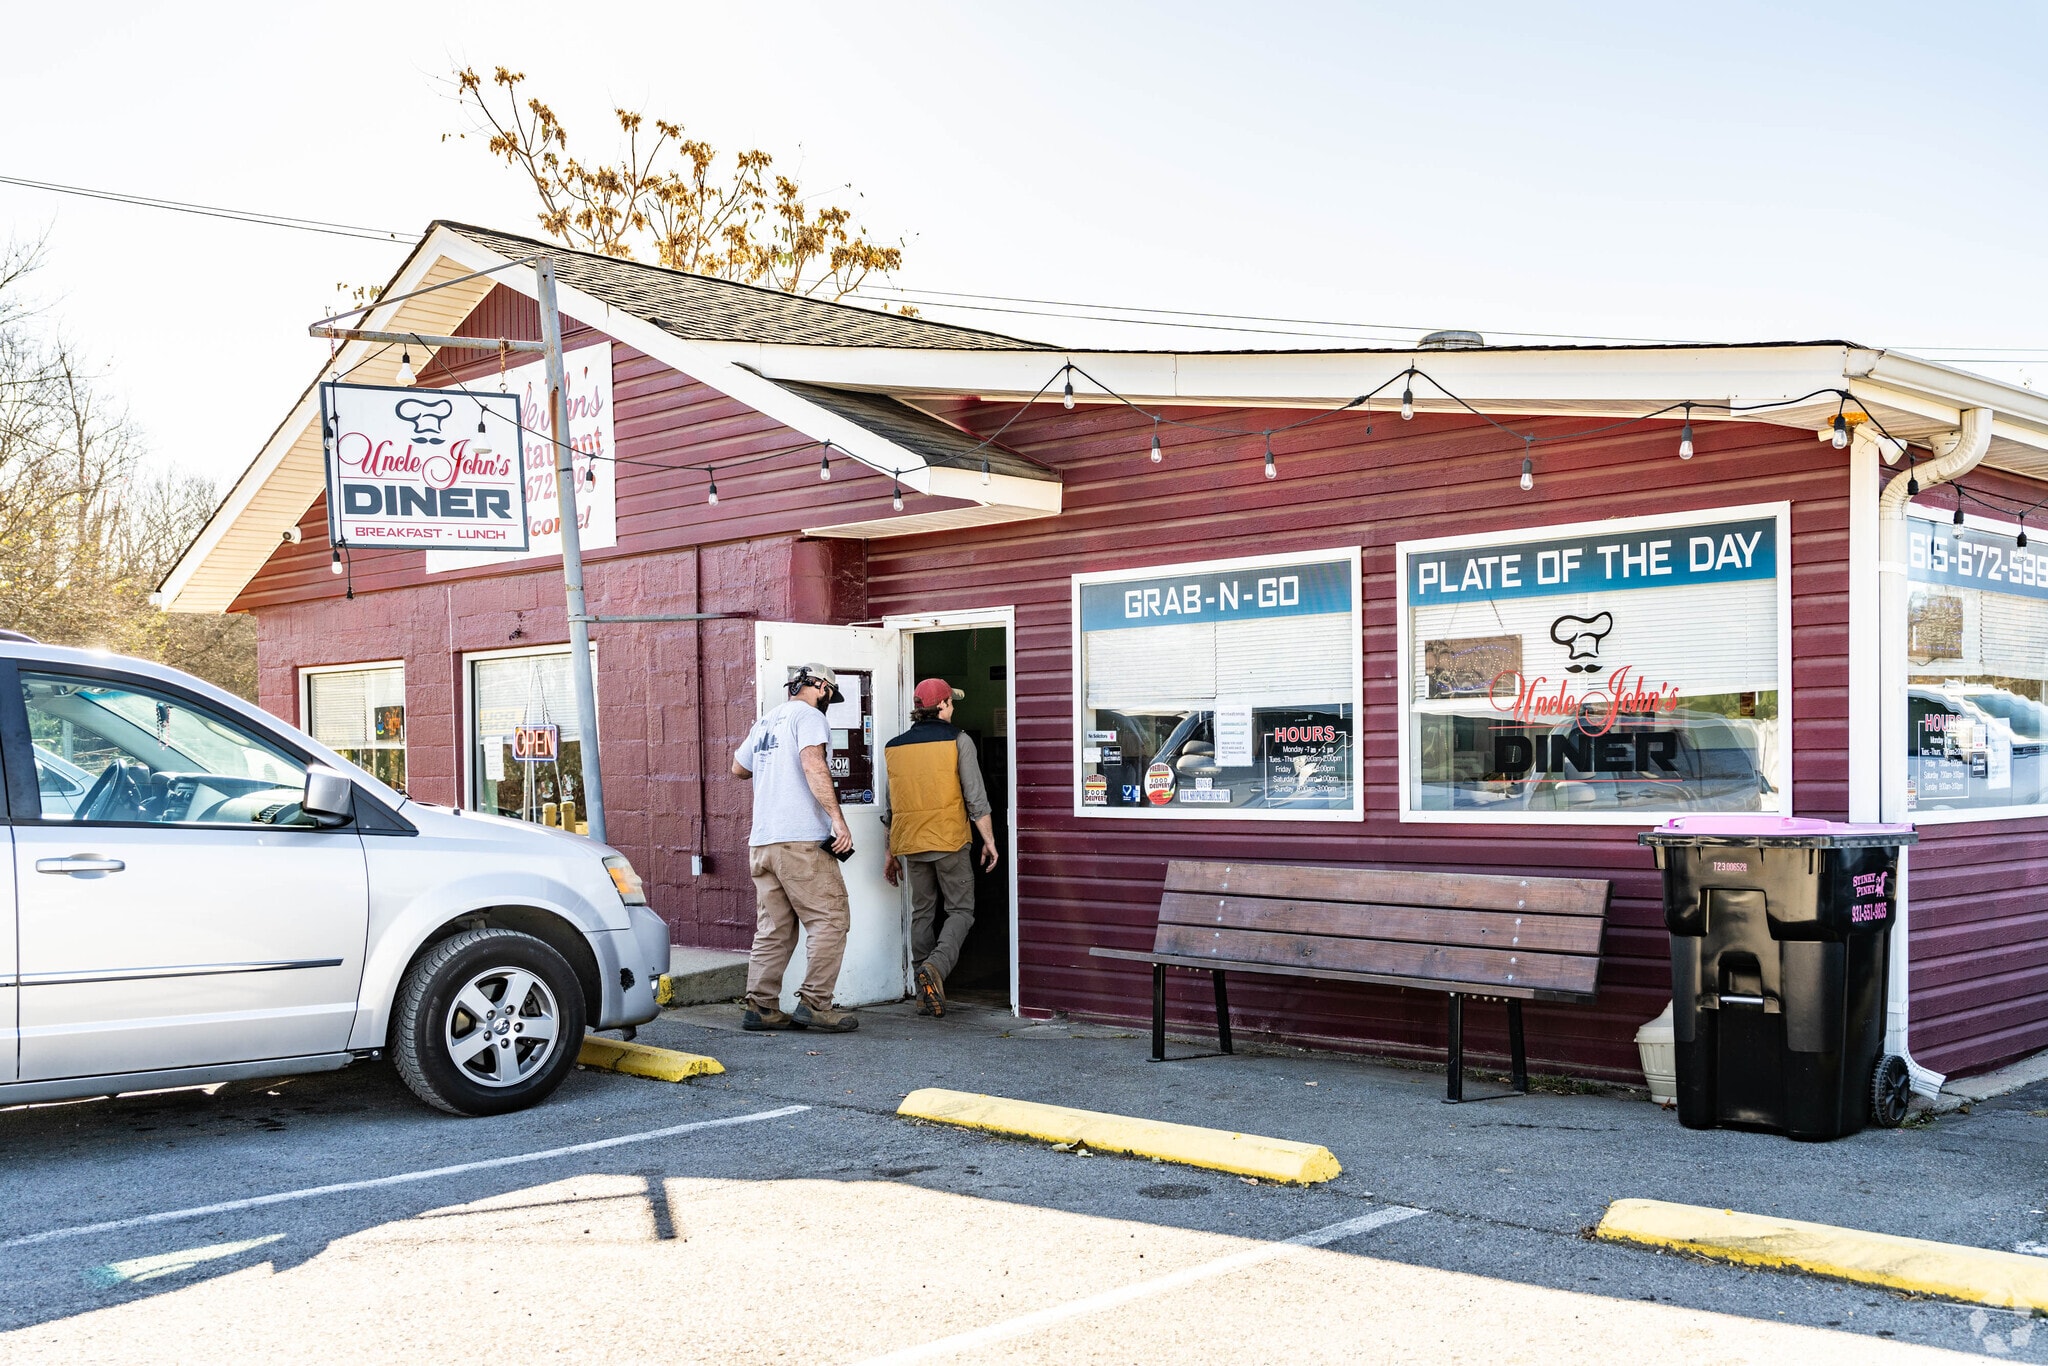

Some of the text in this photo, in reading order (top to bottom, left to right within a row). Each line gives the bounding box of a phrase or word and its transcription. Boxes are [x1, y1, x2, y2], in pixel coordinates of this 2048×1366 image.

[337, 432, 511, 490] Uncle John's
[343, 483, 513, 519] DINER
[355, 526, 442, 539] BREAKFAST
[457, 528, 506, 540] LUNCH
[1418, 531, 1763, 595] PLATE OF THE DAY
[1124, 575, 1300, 619] GRAB-N-GO
[1489, 664, 1680, 737] Uncle John's
[516, 730, 555, 756] OPEN
[1274, 725, 1336, 743] HOURS
[1283, 746, 1304, 754] Monday
[1494, 733, 1680, 773] DINER
[1149, 763, 1169, 772] PREMIUM
[1275, 766, 1291, 774] Friday
[1273, 776, 1295, 784] Saturday
[1274, 786, 1293, 794] Sunday
[1856, 885, 1876, 897] PINKY
